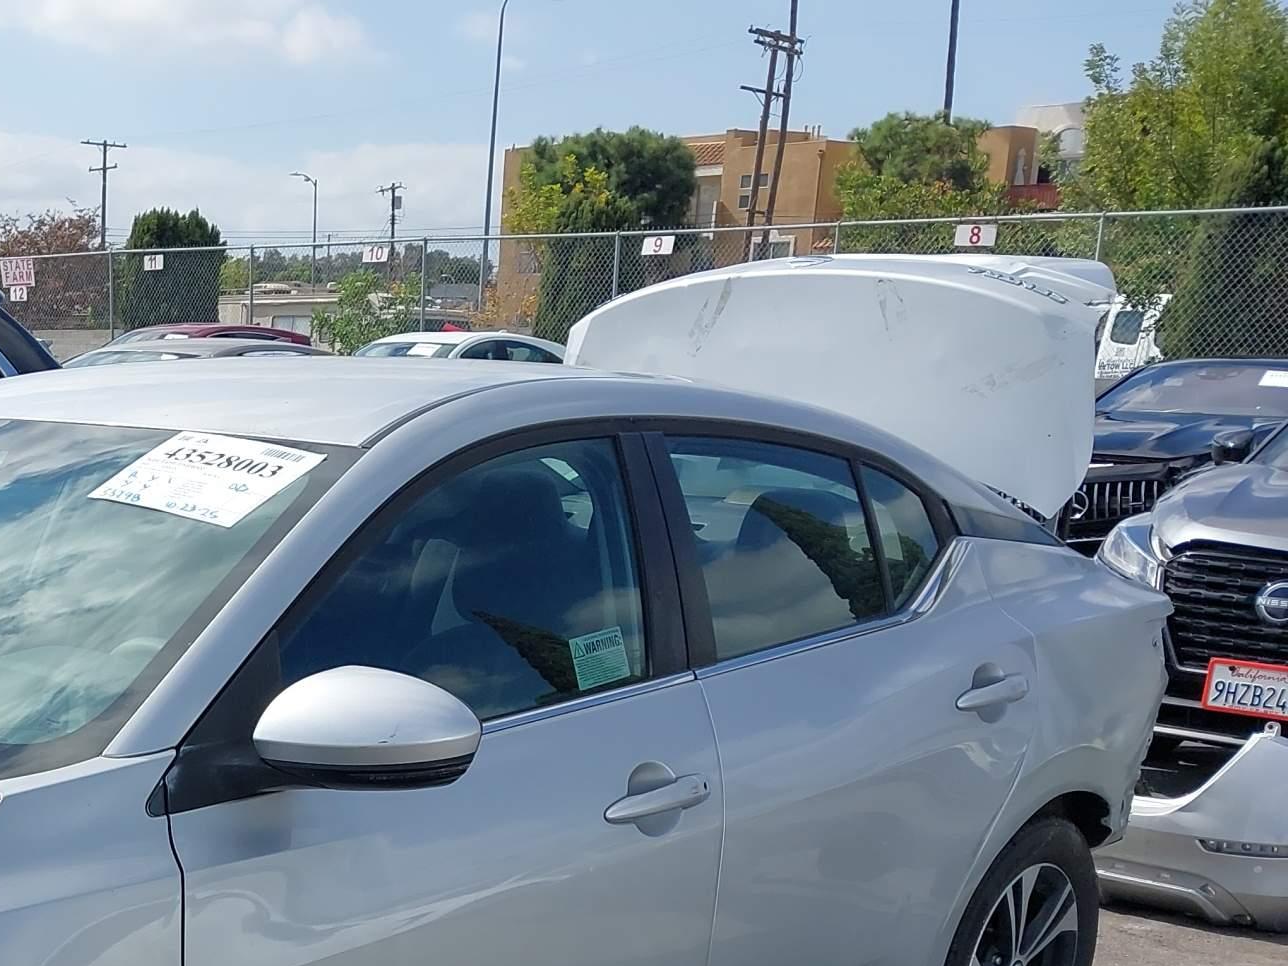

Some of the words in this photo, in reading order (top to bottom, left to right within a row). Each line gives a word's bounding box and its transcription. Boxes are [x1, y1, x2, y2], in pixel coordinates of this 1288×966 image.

[969, 226, 982, 245] 8
[653, 236, 663, 253] 9
[368, 246, 384, 261] 10
[2, 259, 33, 271] STATE
[148, 255, 157, 269] 11
[5, 270, 33, 282] FARM
[12, 287, 25, 300] 12
[164, 447, 284, 478] 43528003
[1212, 680, 1288, 712] 9HZB24
